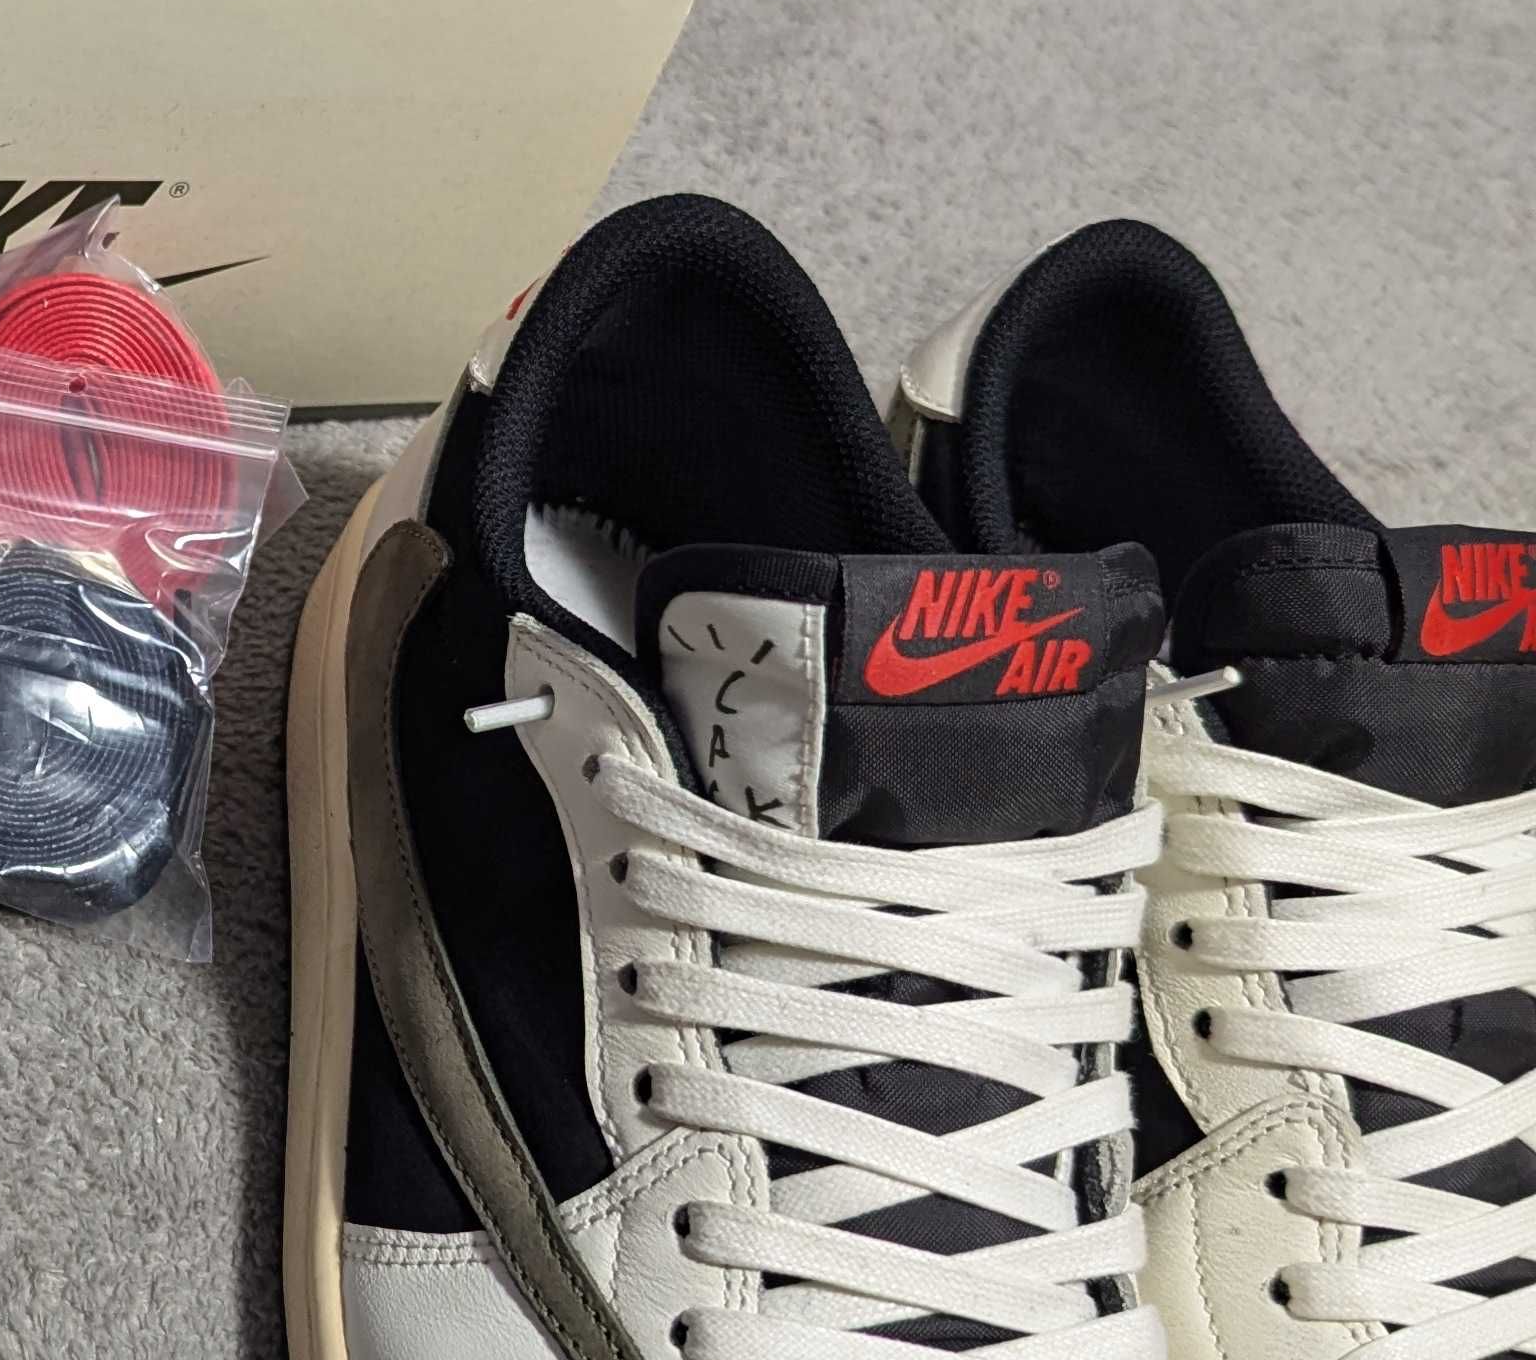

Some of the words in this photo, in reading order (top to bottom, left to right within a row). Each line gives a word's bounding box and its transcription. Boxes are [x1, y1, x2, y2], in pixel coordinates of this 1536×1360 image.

[898, 568, 1042, 640] NIKE
[1441, 542, 1530, 604] NIKE
[995, 639, 1093, 697] AIR
